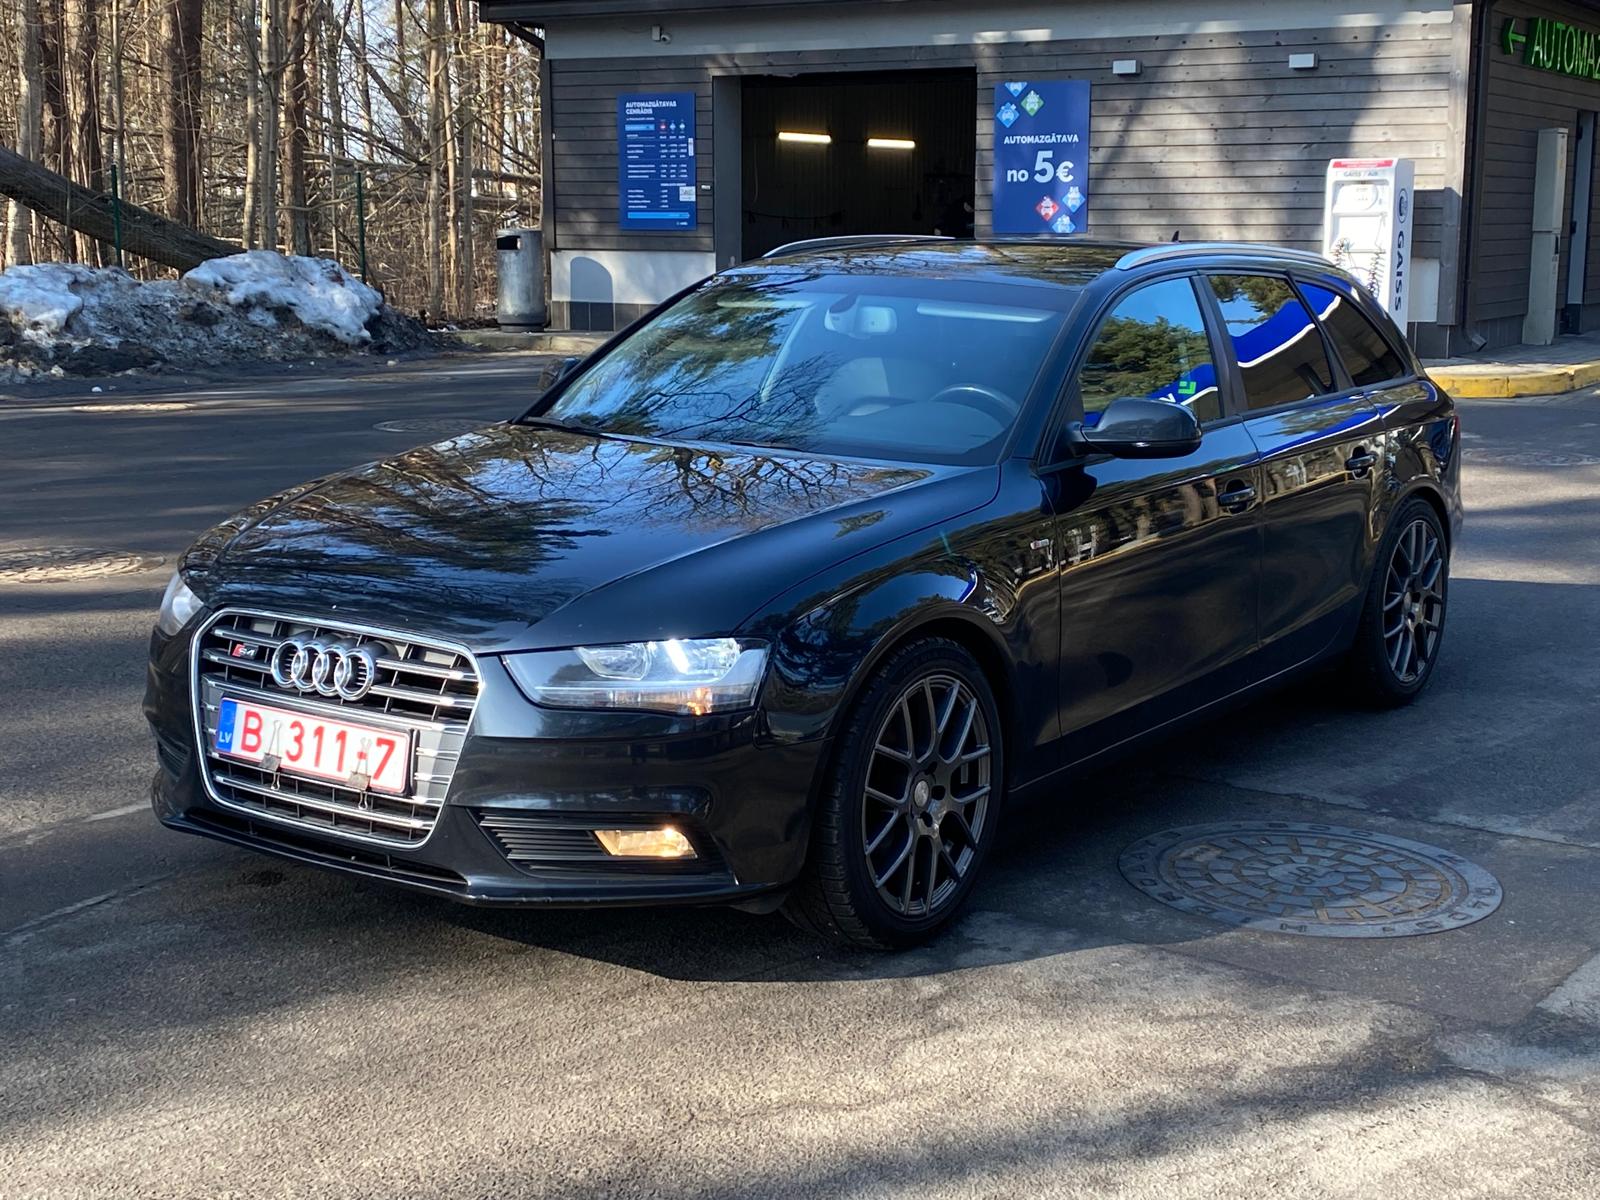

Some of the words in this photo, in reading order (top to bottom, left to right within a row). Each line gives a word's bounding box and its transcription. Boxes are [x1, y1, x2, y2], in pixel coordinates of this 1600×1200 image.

[1003, 133, 1079, 145] AUTOMAZGĀTAVA
[1007, 170, 1029, 183] no
[1033, 150, 1074, 184] 5€
[1394, 230, 1405, 312] GAISS
[218, 731, 232, 744] LV
[240, 710, 262, 753] B
